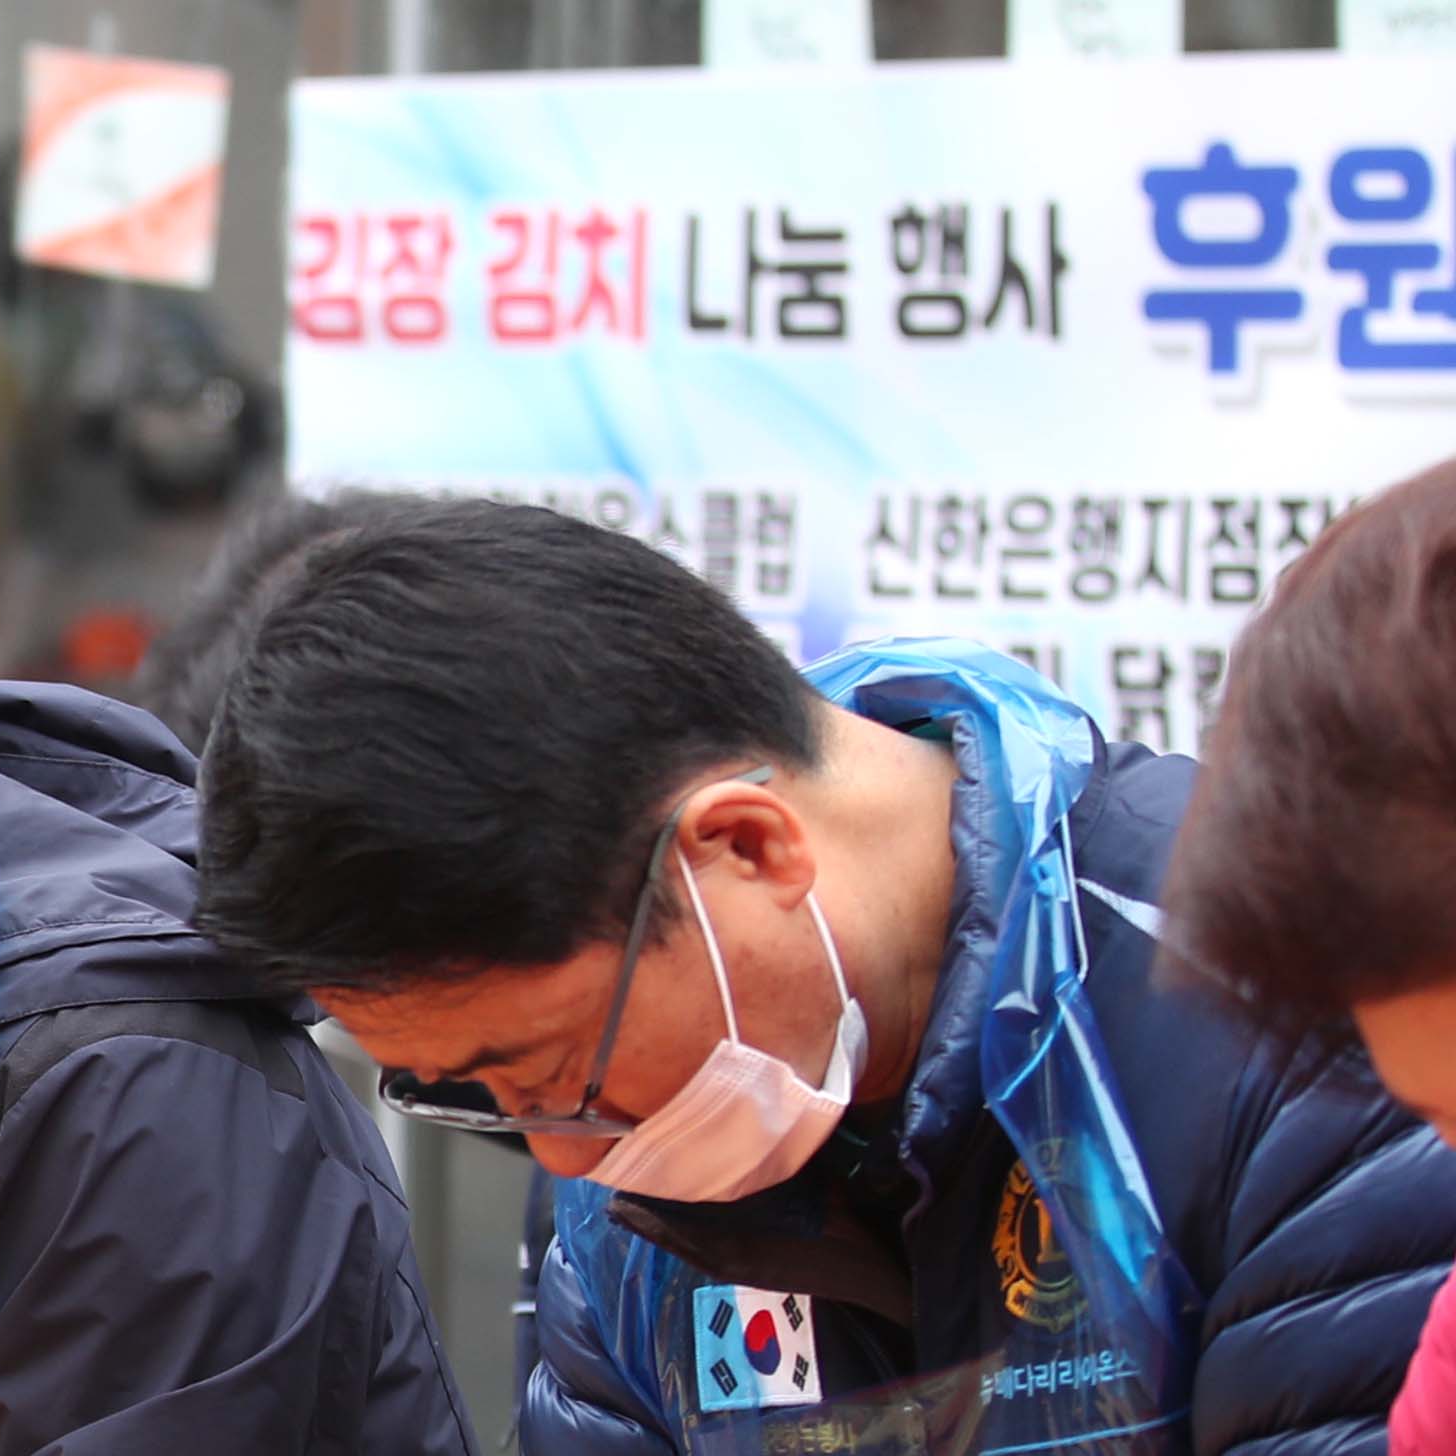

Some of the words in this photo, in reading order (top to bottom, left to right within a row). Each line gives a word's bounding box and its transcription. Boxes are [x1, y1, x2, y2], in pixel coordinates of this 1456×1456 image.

[292, 213, 454, 341] 김장
[487, 208, 649, 341] 김치
[686, 206, 848, 341] 나눔
[890, 201, 1069, 340] 행사
